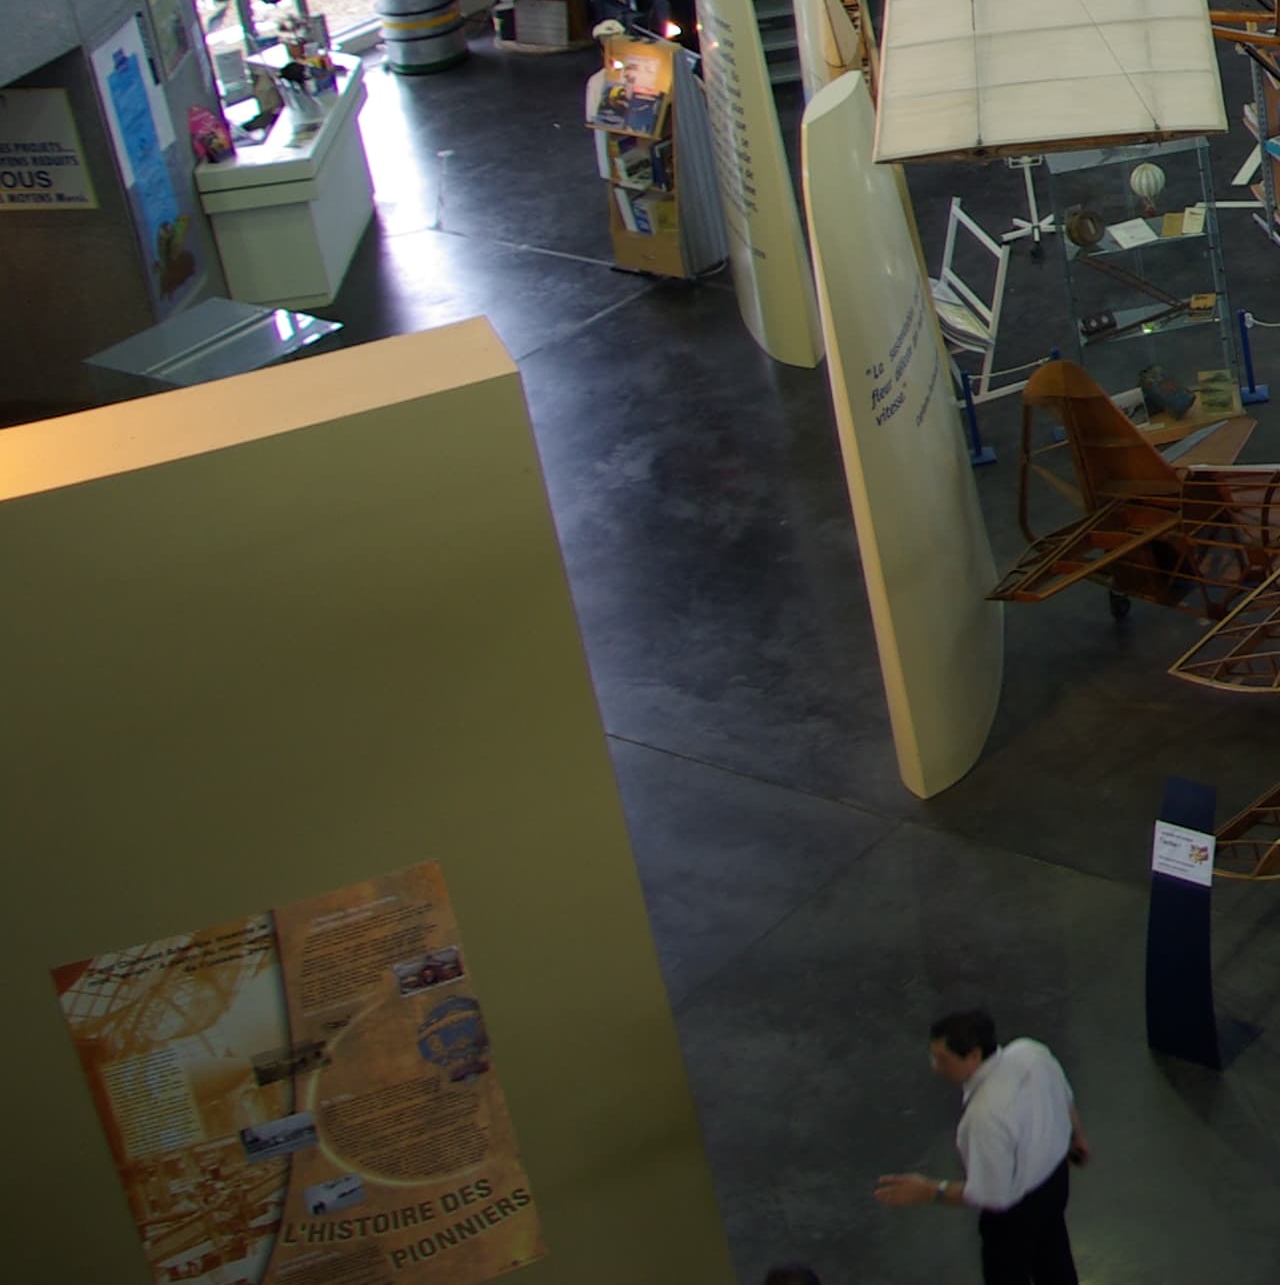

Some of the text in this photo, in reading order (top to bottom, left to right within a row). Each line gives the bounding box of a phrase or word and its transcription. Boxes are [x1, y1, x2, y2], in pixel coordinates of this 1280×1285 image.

[282, 1178, 493, 1244] L'HISTOIRE DES
[390, 1187, 532, 1270] PIONNIERS
